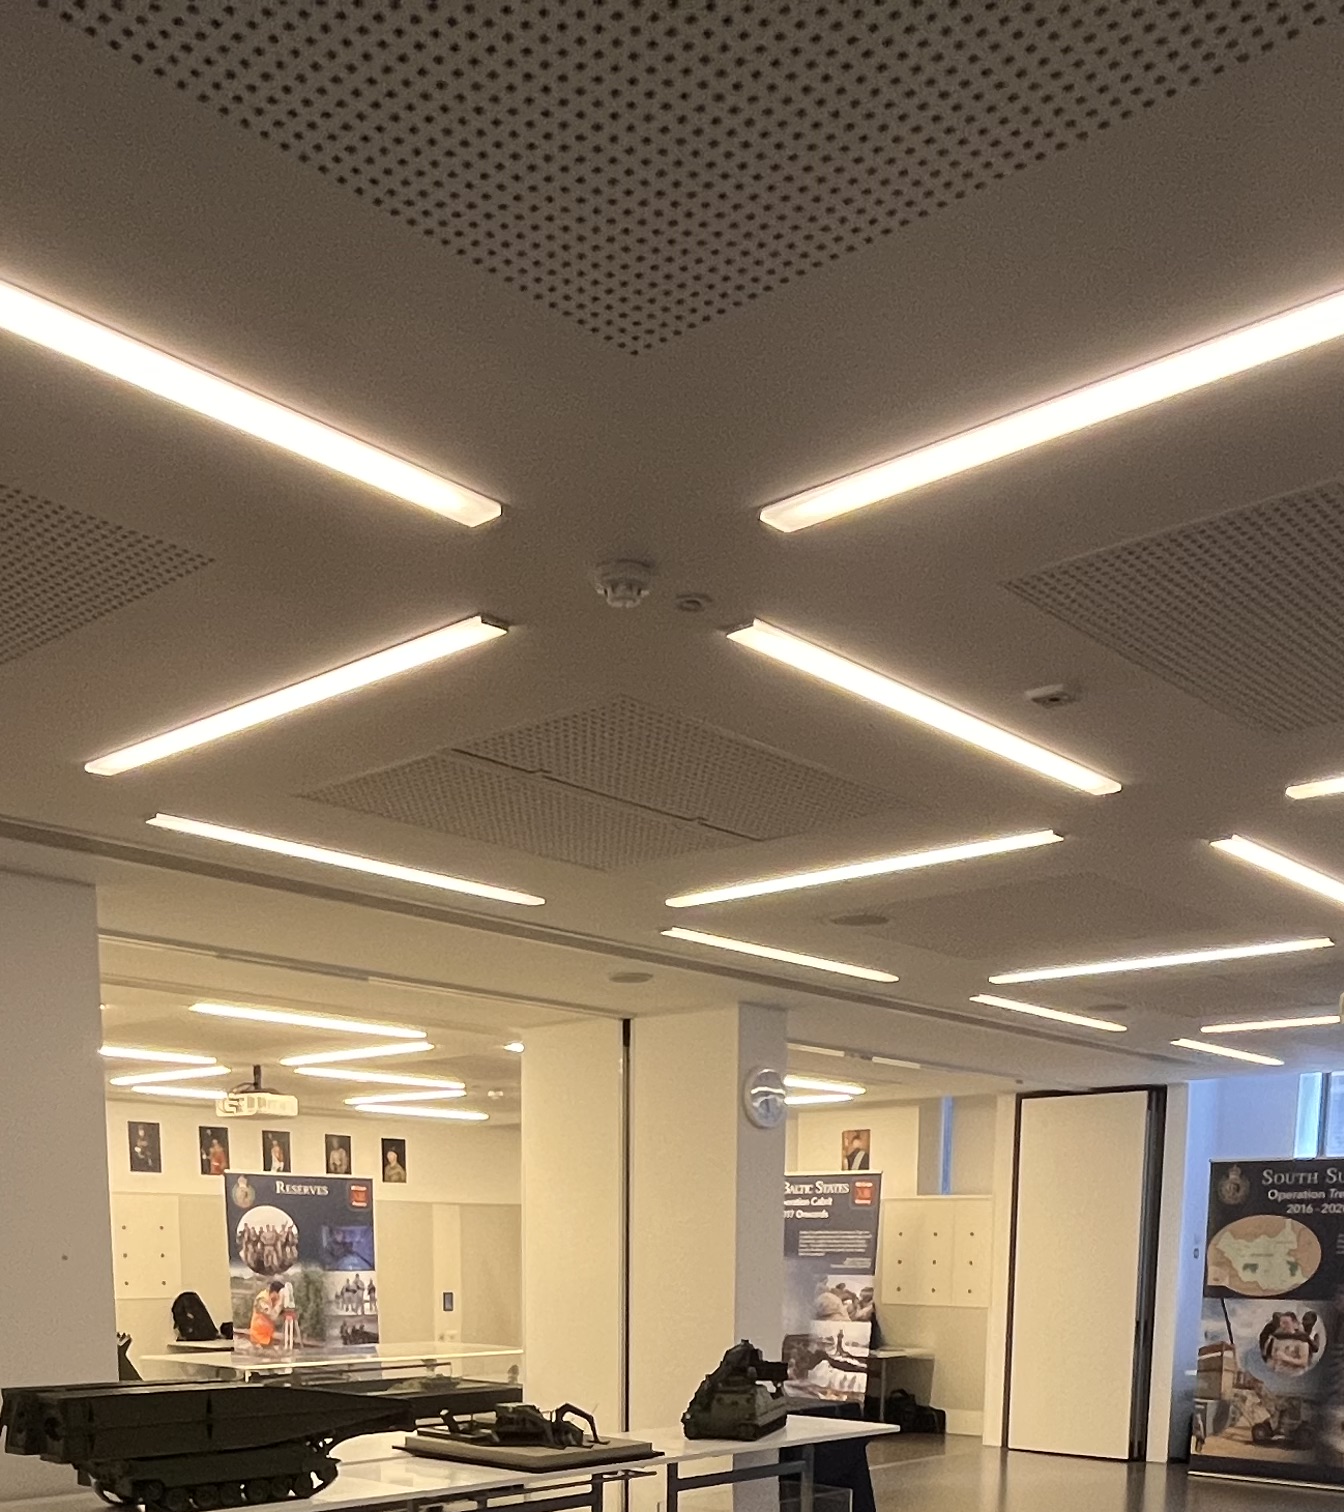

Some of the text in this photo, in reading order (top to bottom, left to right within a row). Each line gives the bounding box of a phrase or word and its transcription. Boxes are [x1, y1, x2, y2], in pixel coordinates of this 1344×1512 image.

[1261, 1168, 1319, 1186] SOUTH
[276, 1180, 329, 1196] RESERVES
[815, 1180, 850, 1194] STATES
[1267, 1189, 1326, 1203] Operation
